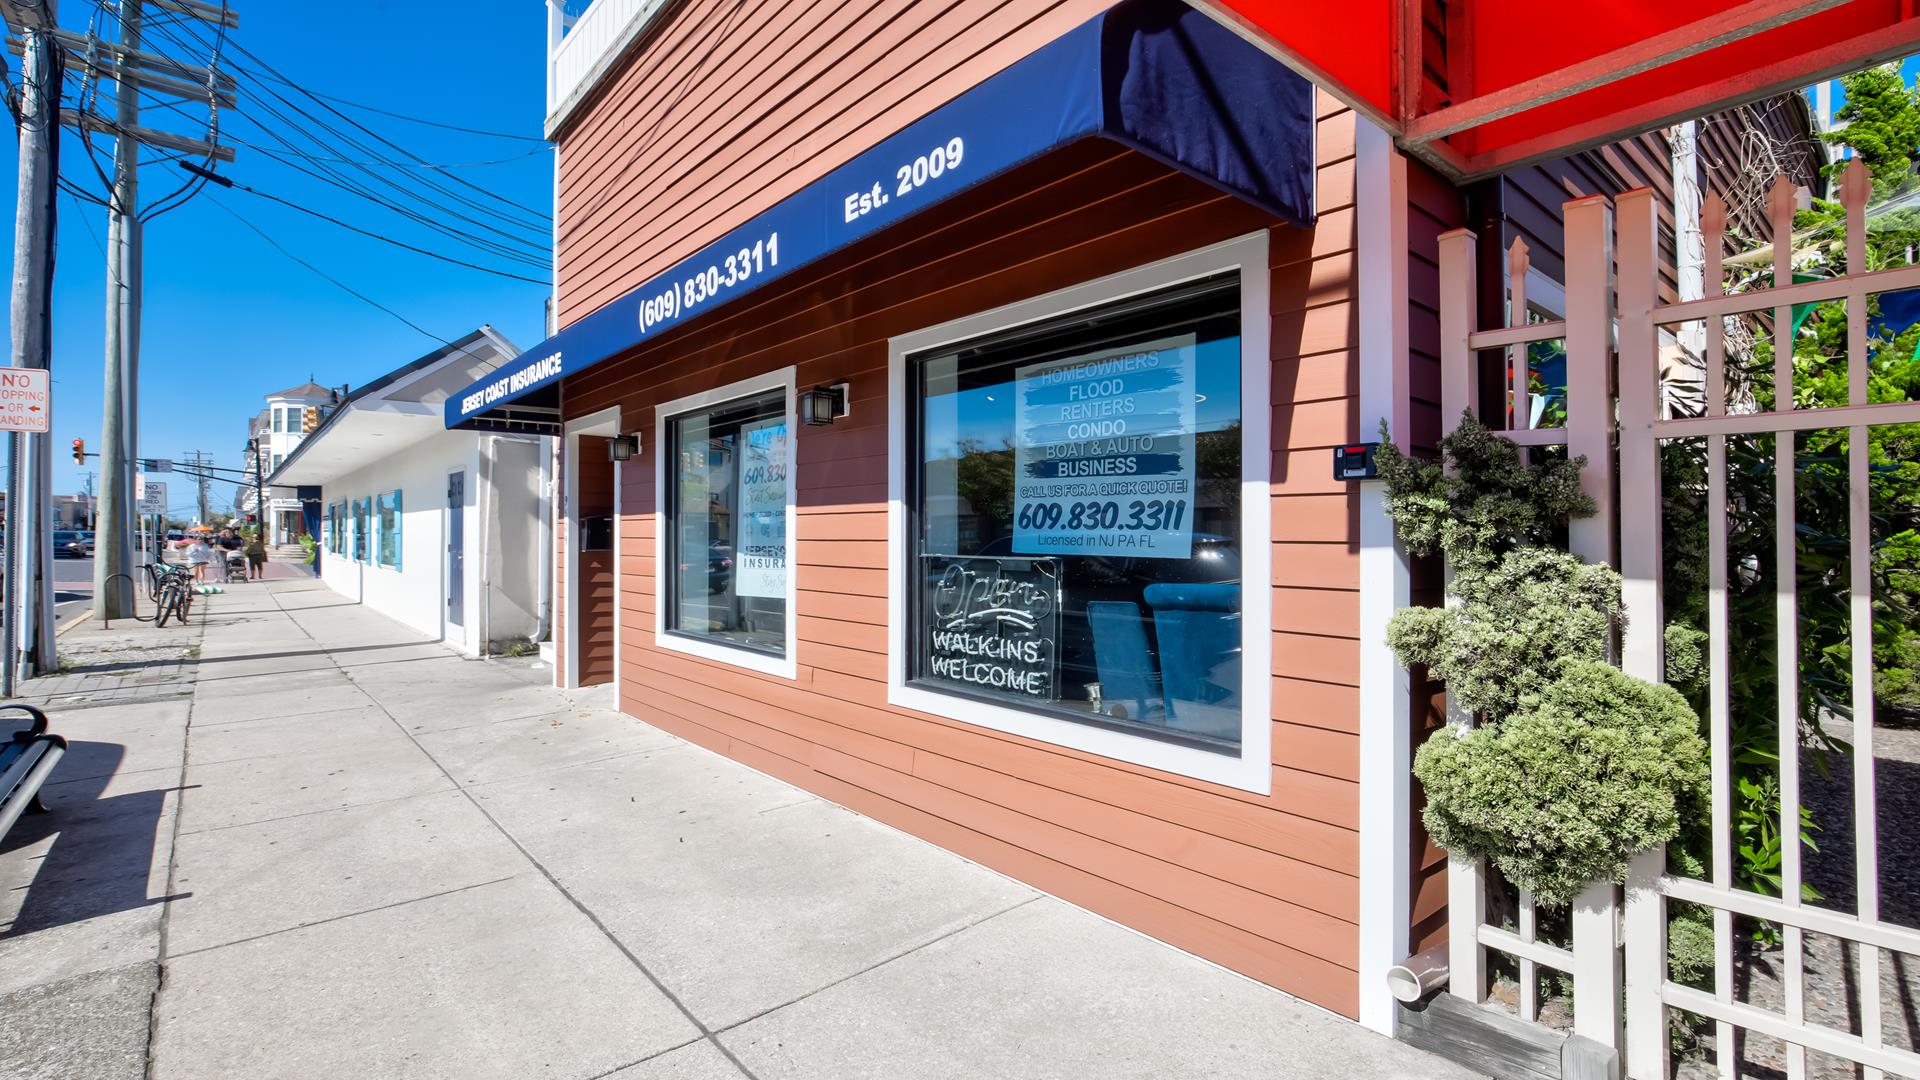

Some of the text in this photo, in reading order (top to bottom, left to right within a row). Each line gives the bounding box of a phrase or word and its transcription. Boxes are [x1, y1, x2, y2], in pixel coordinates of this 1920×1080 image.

[845, 136, 964, 224] Est. 2009
[638, 232, 778, 334] (609) 830-3311
[1041, 351, 1160, 385] HOMEOWNERS
[2, 373, 30, 388] NO
[461, 351, 562, 415] JERSEY COAST INSURANCE
[1069, 378, 1124, 401] FLOOD
[0, 389, 44, 402] OPPING
[8, 402, 24, 413] OR
[1061, 397, 1135, 421] RENTERS
[1067, 419, 1126, 441] CONDO
[1046, 435, 1154, 459] BOAT & AUTO
[1058, 457, 1137, 477] BUSINESS
[1020, 479, 1188, 498] CALL US FOR A QUICK QUOTE!
[1018, 500, 1187, 530] 609.830.3311
[1038, 534, 1156, 548] Licensed in NJ PA FL
[931, 655, 1046, 694] WELCOME
